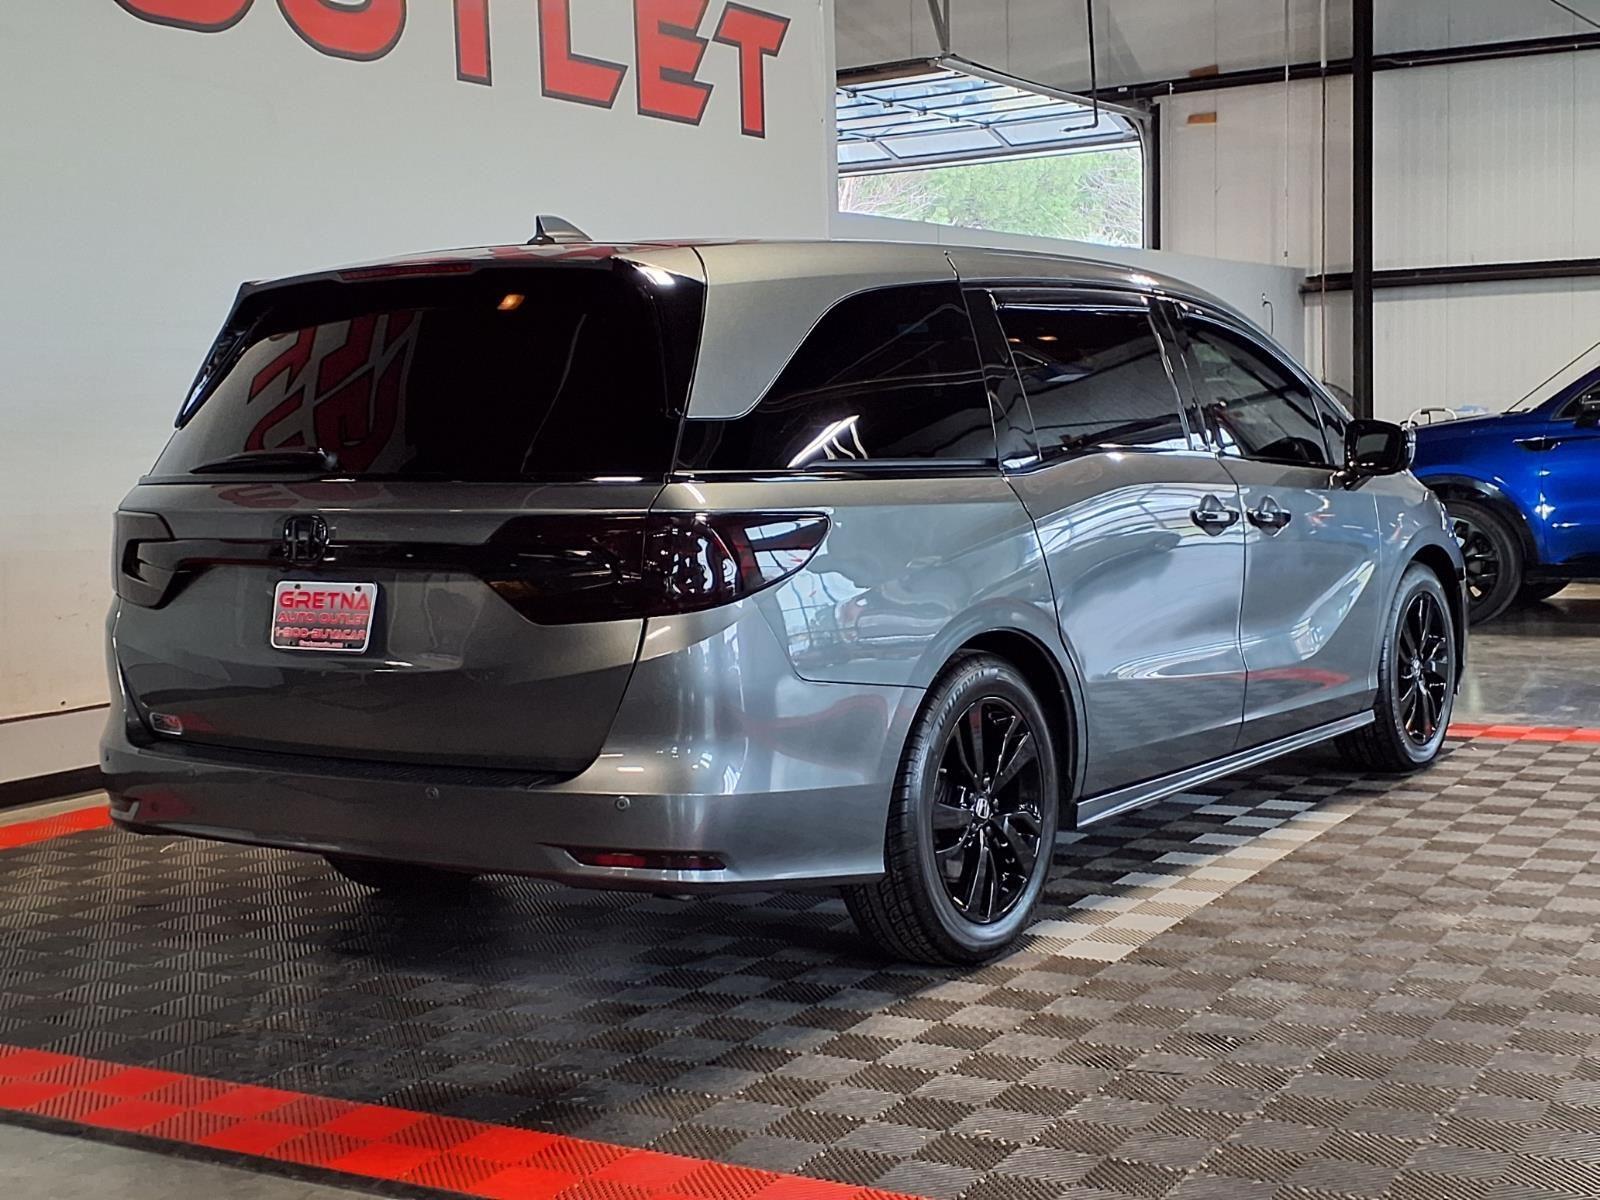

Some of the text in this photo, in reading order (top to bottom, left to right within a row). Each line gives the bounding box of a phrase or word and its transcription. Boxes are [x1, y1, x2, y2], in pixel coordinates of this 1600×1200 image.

[112, 0, 791, 138] TLET
[279, 591, 369, 610] GRETNA
[278, 611, 369, 625] AUTO OUTLET
